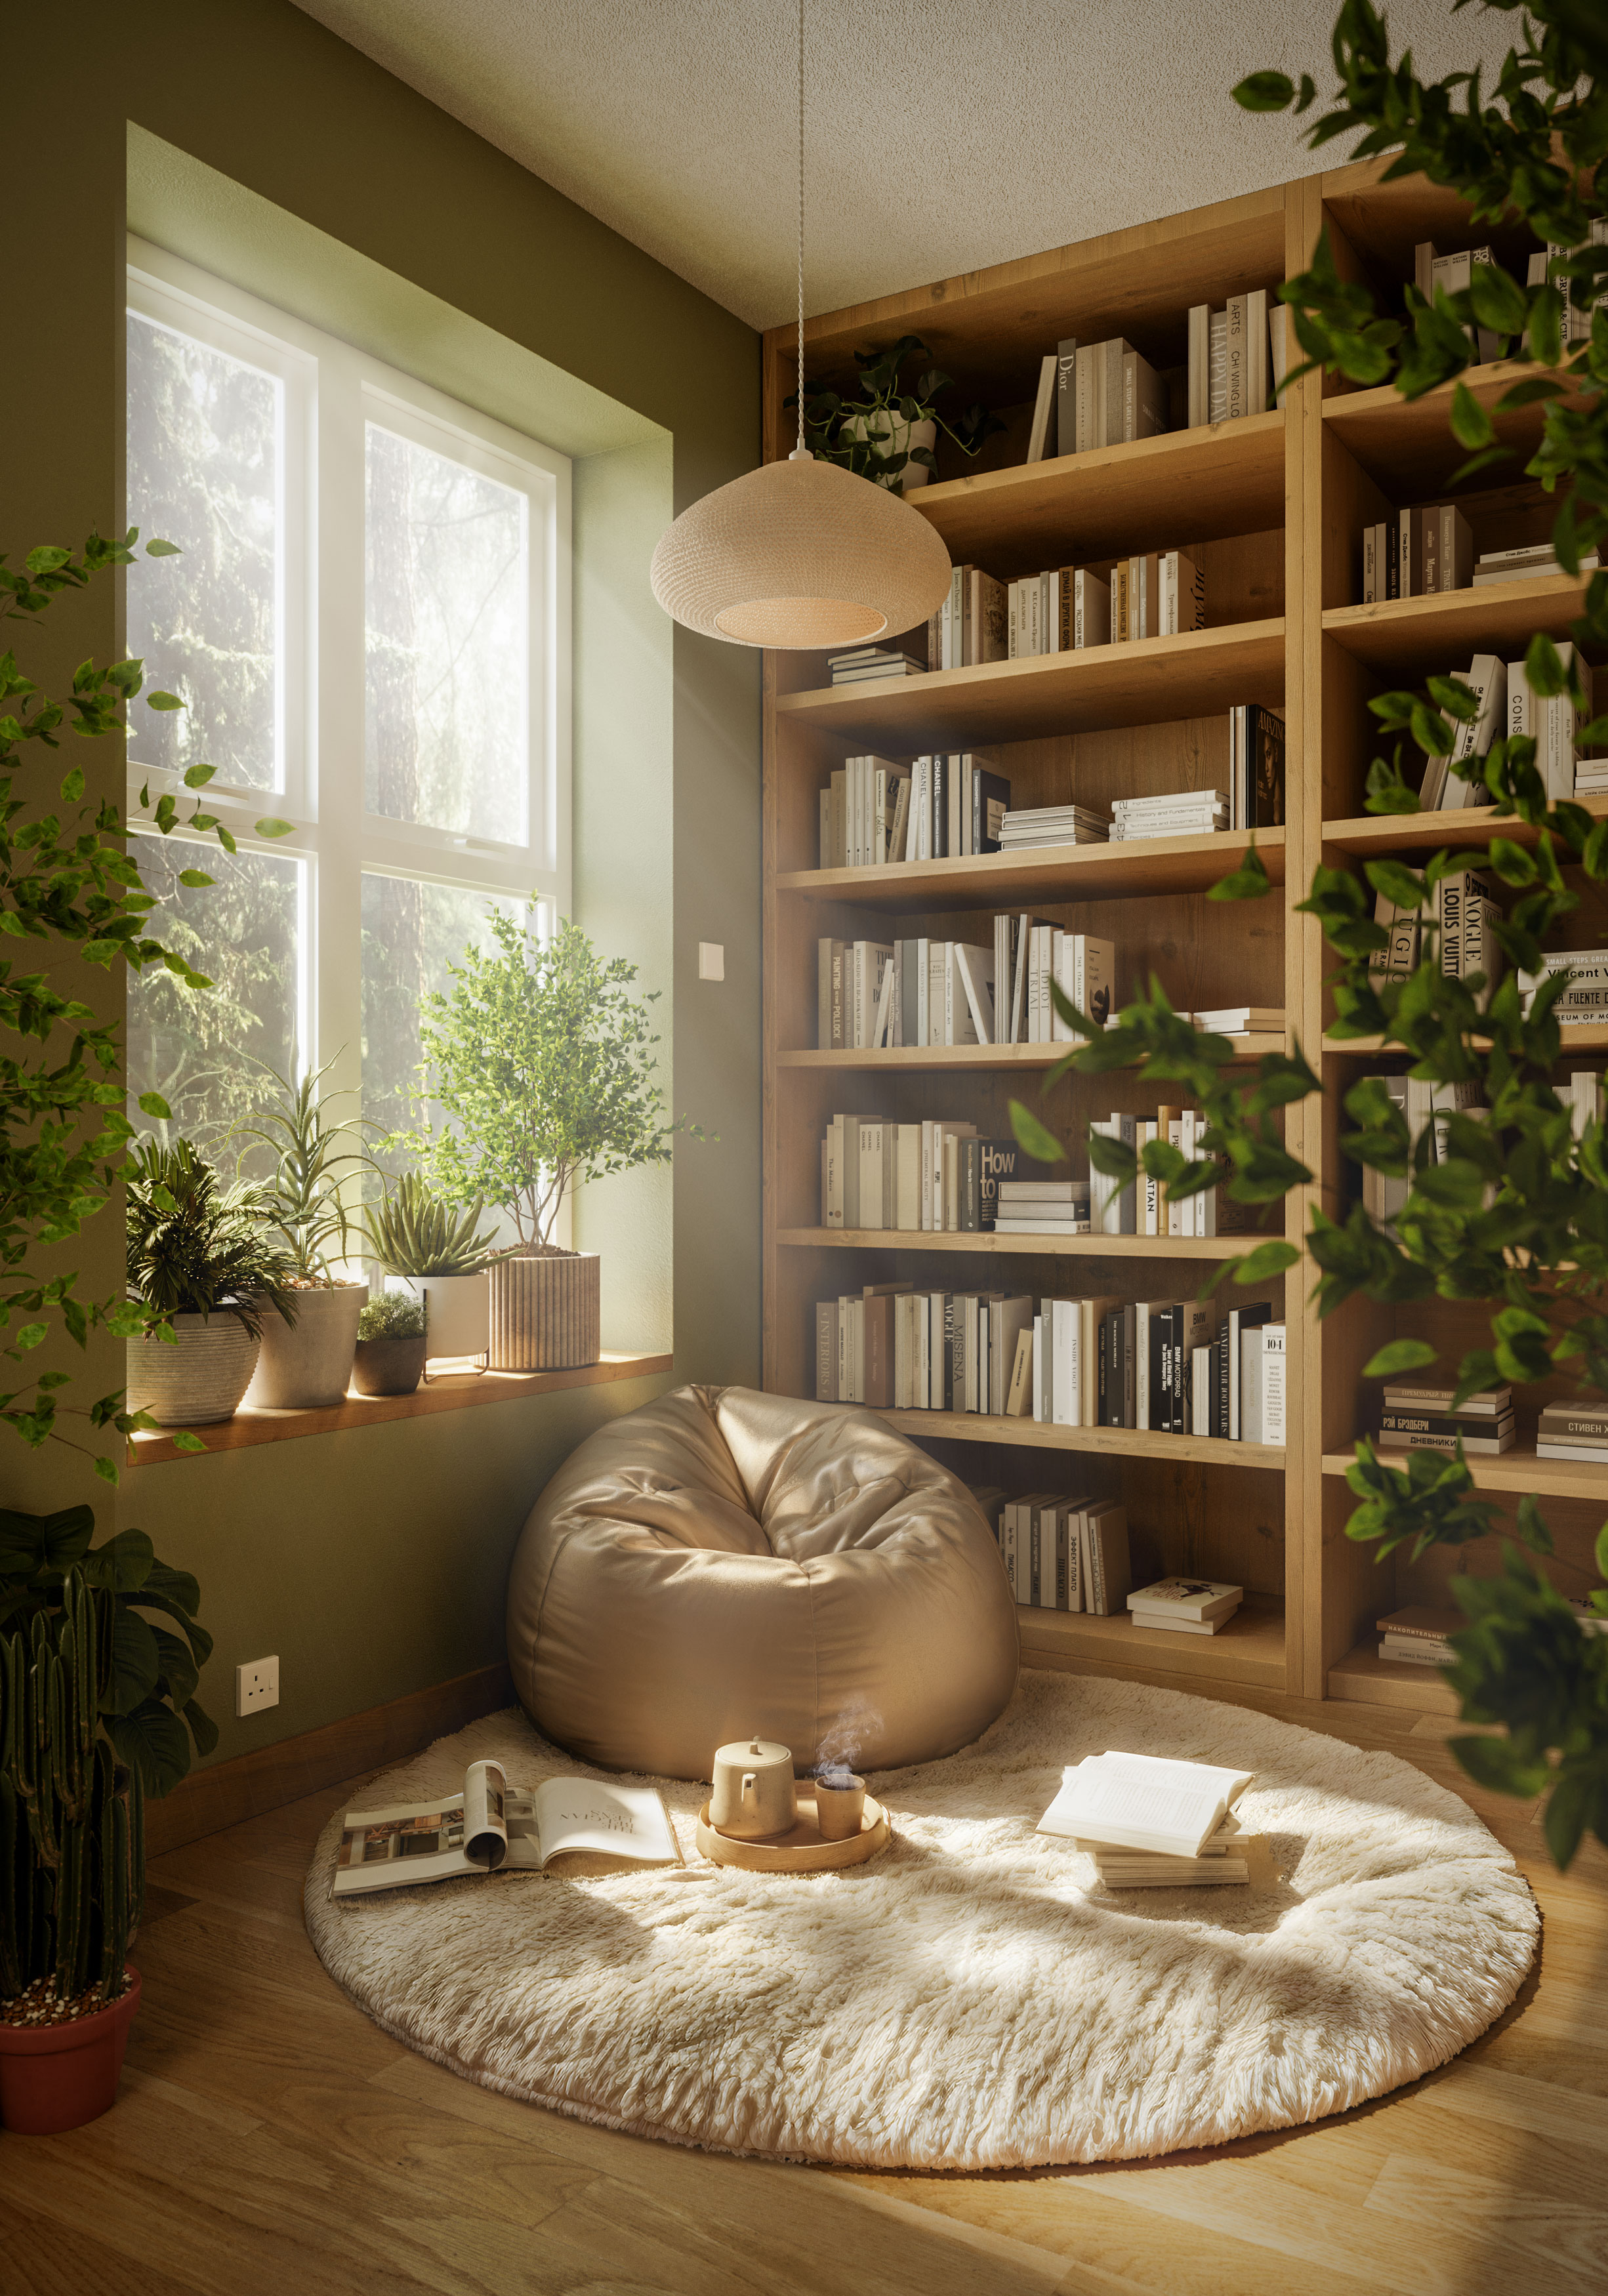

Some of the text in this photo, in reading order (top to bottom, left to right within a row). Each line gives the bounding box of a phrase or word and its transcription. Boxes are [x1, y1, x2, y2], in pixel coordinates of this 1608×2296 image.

[1211, 323, 1227, 384] HAPPY
[1231, 304, 1240, 418] ARTS CHI WING LO
[1060, 353, 1074, 390] Dior
[1426, 558, 1435, 584] Мартин
[1062, 571, 1071, 628] ДУМАЙ ДРУГИХ
[894, 804, 903, 829] VUITTON
[1119, 800, 1128, 810] 2
[876, 815, 884, 836] Lolita
[1117, 823, 1125, 832] 3
[1444, 888, 1460, 929] LOUIS
[1465, 897, 1481, 962] VOGUE
[1030, 969, 1039, 1014] TRIAL
[1041, 970, 1050, 1011] IDIOT
[1569, 993, 1600, 1004] FUENTE
[981, 1146, 1016, 1174] How
[980, 1173, 996, 1199] to
[945, 1304, 954, 1342] VOGUE
[1189, 1322, 1209, 1336] MOTORRAD
[1193, 1311, 1206, 1325] BMW
[821, 1320, 830, 1385] INTERIORS
[954, 1324, 964, 1382] MISENA
[1401, 1389, 1439, 1398] ПРЕМУДРЫЙ
[1383, 1416, 1429, 1431] РЭЙ БРЭДБЕРИ
[1568, 1422, 1601, 1433] СТИВЕН
[1410, 1437, 1456, 1447] ДНЕВНИКИ
[1416, 1653, 1437, 1662] ЙОФФИ,
